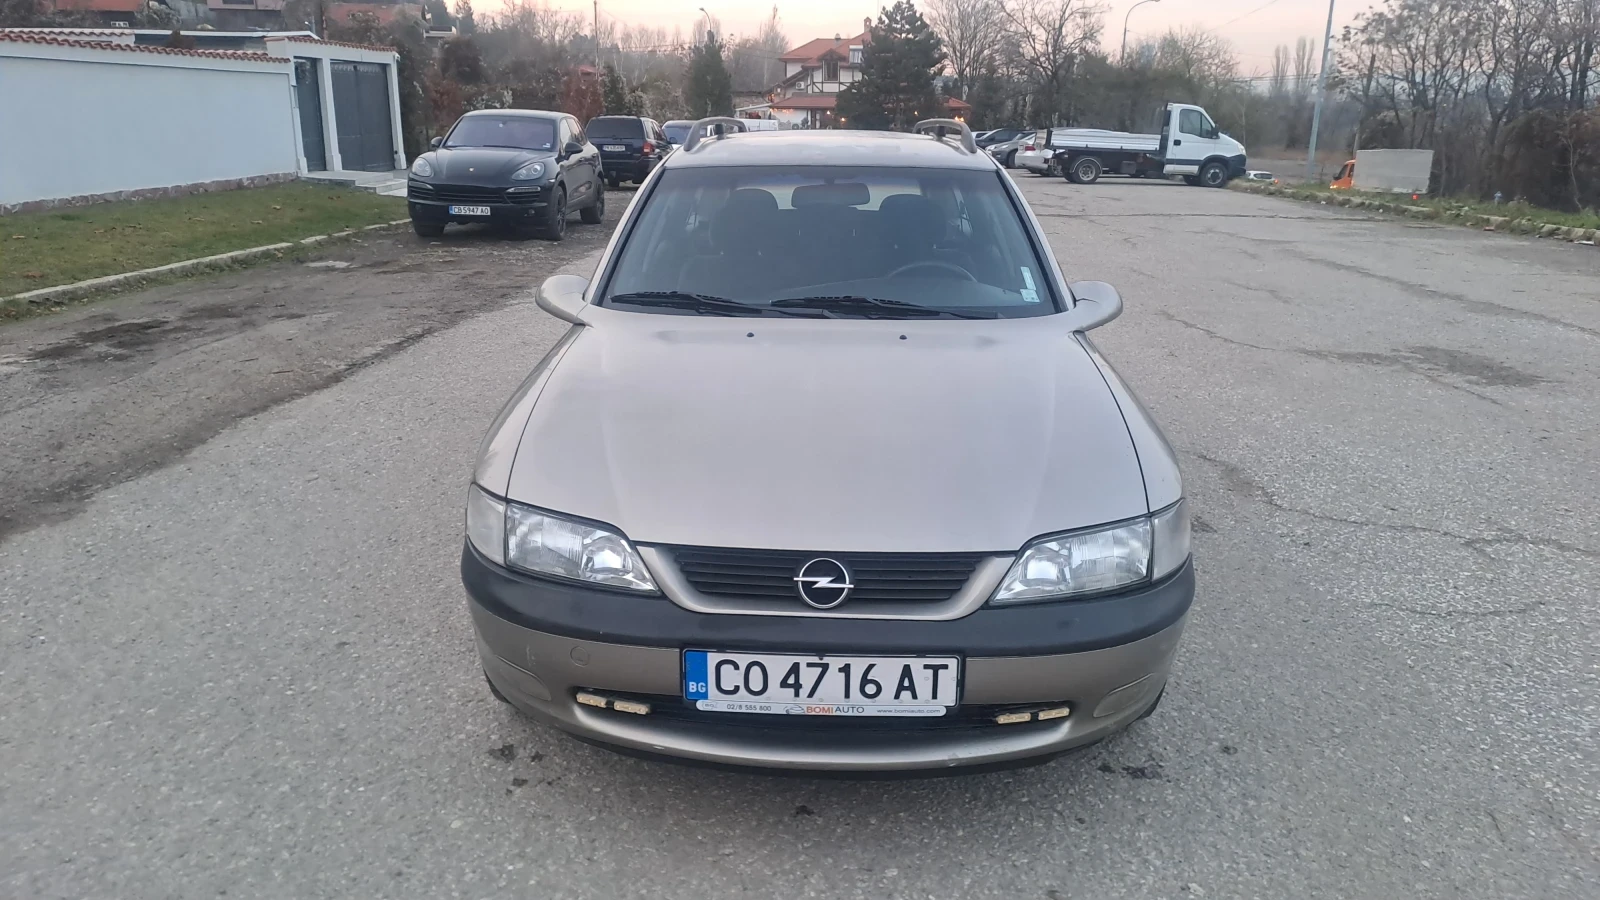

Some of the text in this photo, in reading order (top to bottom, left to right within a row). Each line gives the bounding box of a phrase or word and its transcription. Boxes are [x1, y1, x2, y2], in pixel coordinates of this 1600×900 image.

[715, 659, 949, 700] CO 4716 AT
[689, 681, 706, 693] BG
[726, 703, 772, 712] 02/8 555 800
